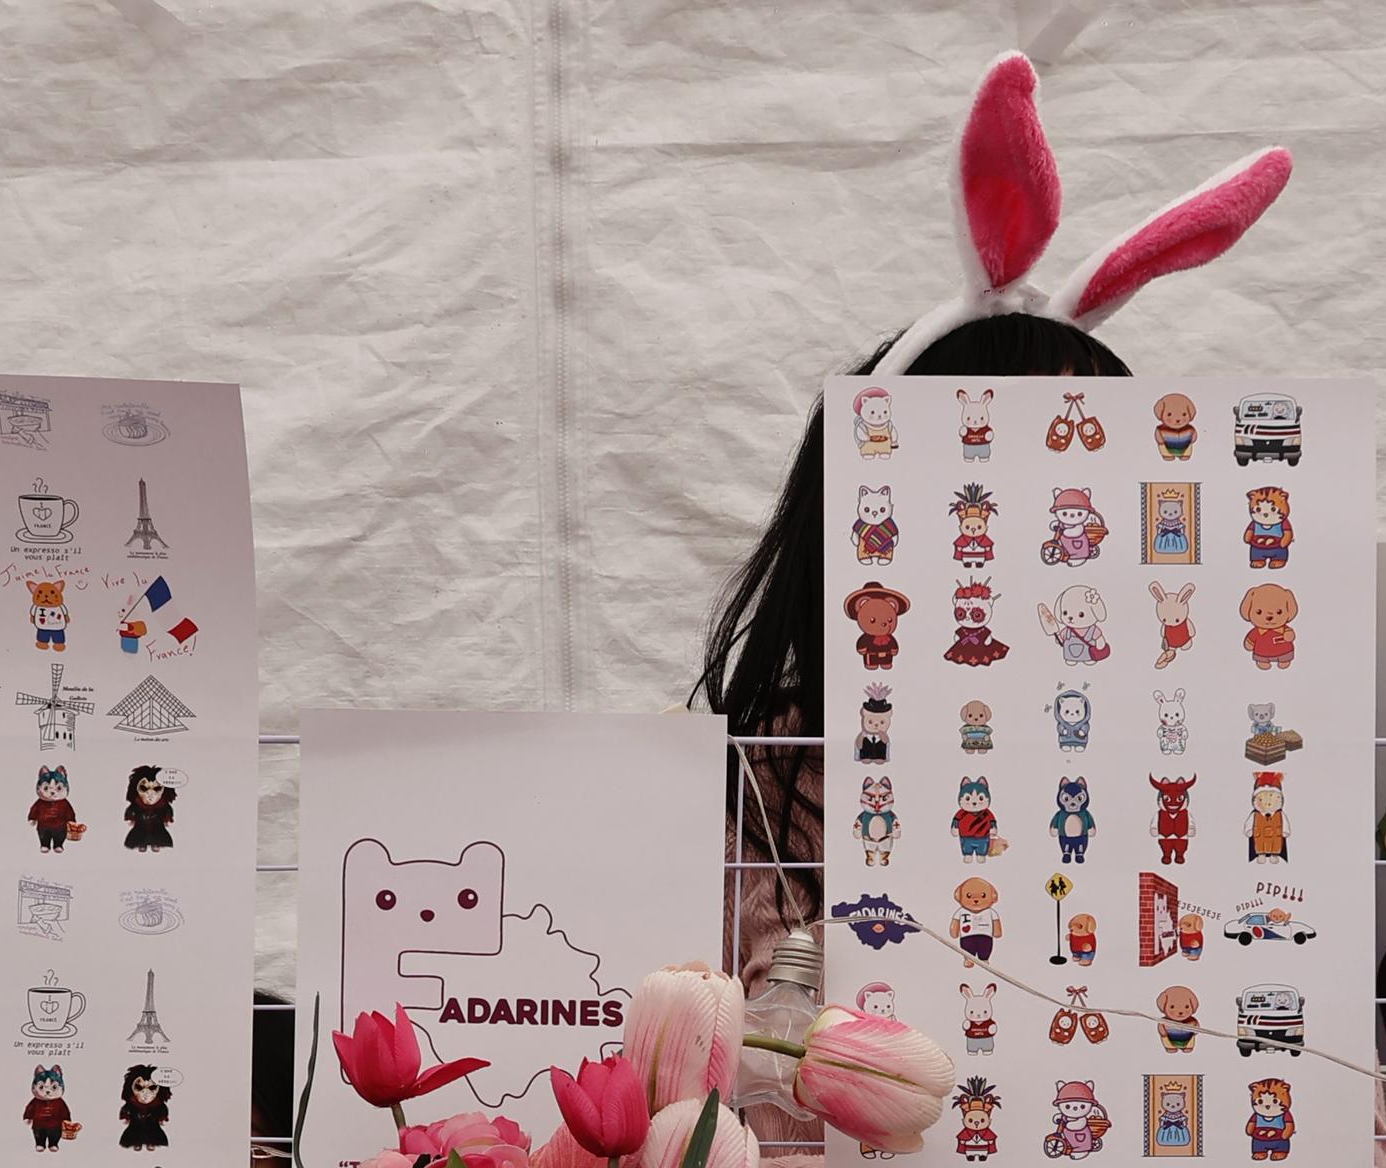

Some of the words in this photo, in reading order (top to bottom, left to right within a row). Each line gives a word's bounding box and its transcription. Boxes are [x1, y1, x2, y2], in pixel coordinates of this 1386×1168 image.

[23, 547, 60, 555] expresso
[54, 565, 90, 577] France
[101, 574, 126, 591] Vive
[439, 997, 624, 1027] ADARINES
[27, 1042, 63, 1050] expresso
